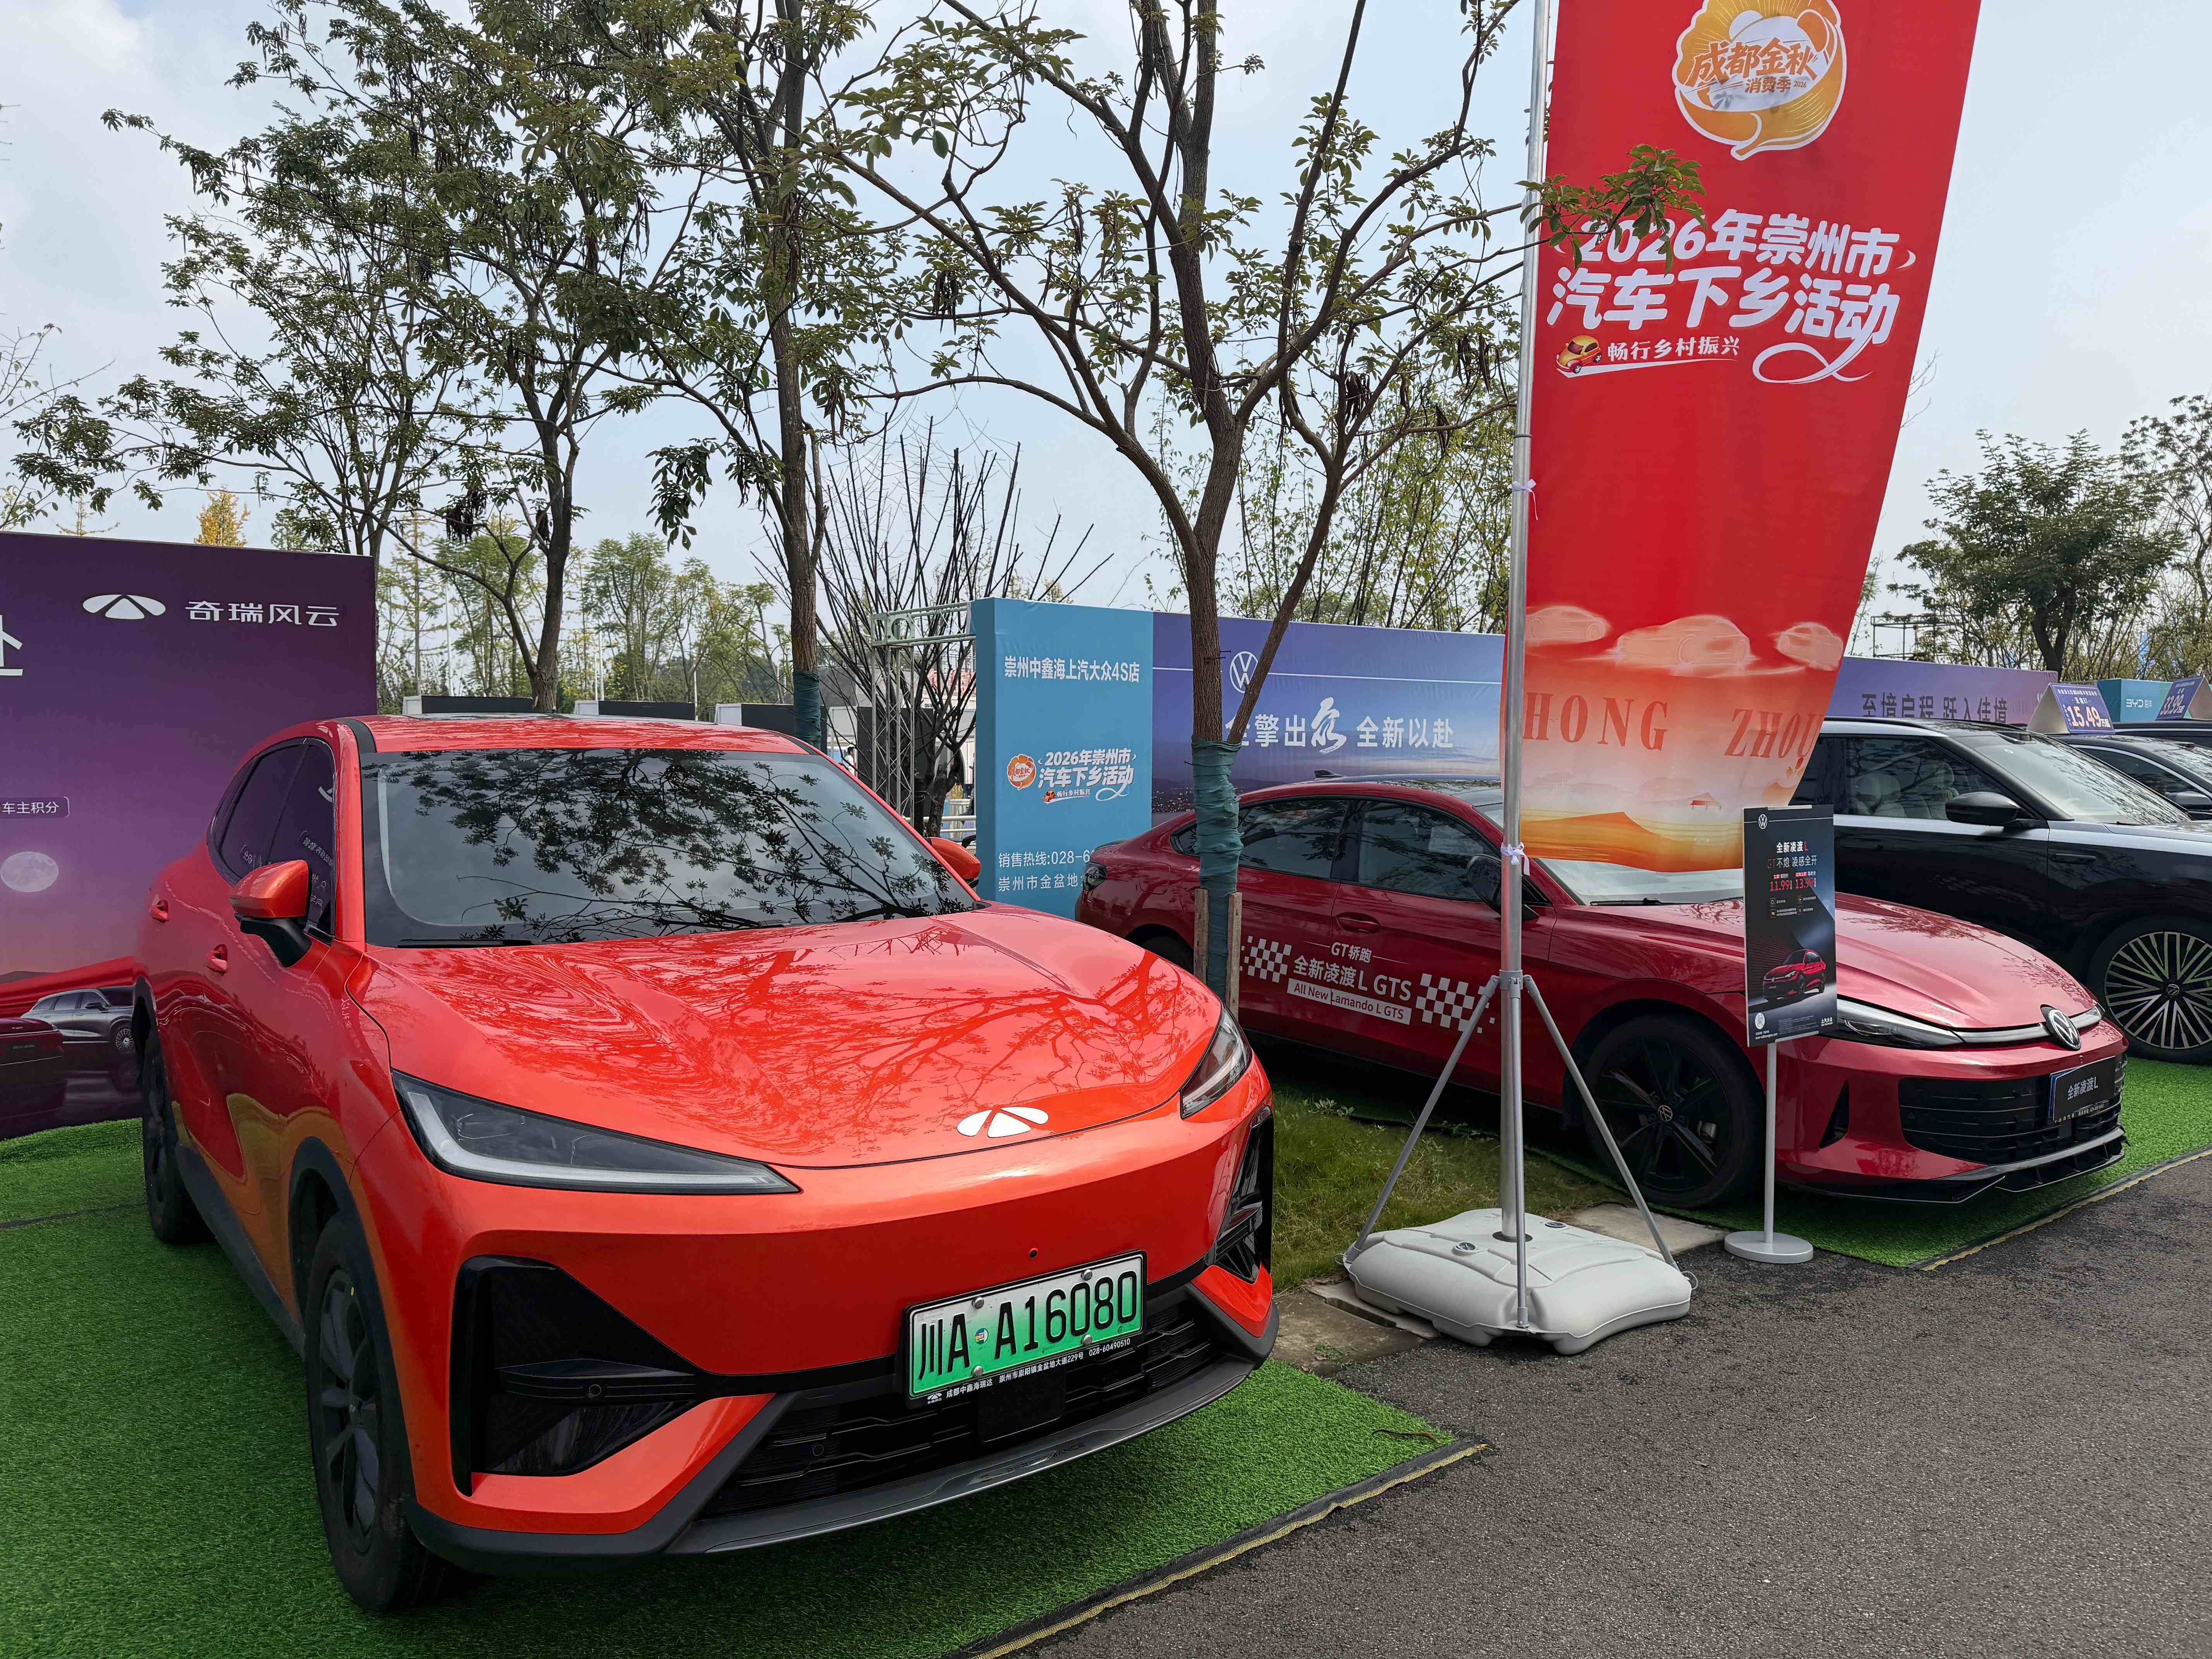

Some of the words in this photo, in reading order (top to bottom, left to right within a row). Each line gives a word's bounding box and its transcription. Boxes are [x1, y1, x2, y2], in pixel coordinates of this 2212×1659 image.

[1683, 37, 1817, 86] 成都金秋
[1745, 76, 1791, 93] 消费季
[1793, 80, 1807, 88] 2026
[1574, 209, 1900, 279] 2026年崇州市
[1547, 266, 1900, 347] 汽车下乡活动
[1607, 335, 1740, 361] 畅行乡村振兴
[185, 601, 339, 627] 奇瑞风云
[1005, 655, 1140, 684] 崇州中鑫海上汽大众4S店
[1357, 716, 1453, 748] 全新以赴
[1724, 709, 1825, 758] ZHOU
[1044, 748, 1132, 767] 2026年崇州市
[1038, 765, 1134, 788] 汽车下乡活动
[998, 849, 1094, 868] 销售热线:028-6
[998, 872, 1083, 892] 崇州市金盆地
[1331, 941, 1372, 964] GT轿跑
[1374, 974, 1412, 1001] GTS
[1294, 983, 1307, 995] All
[1308, 986, 1328, 1000] New
[1331, 992, 1374, 1012] Lamando
[1376, 1003, 1381, 1013] L
[1384, 1005, 1403, 1020] GTS
[2068, 1076, 2099, 1100] 全新凌渡L
[1089, 1338, 1130, 1357] 028-60490510
